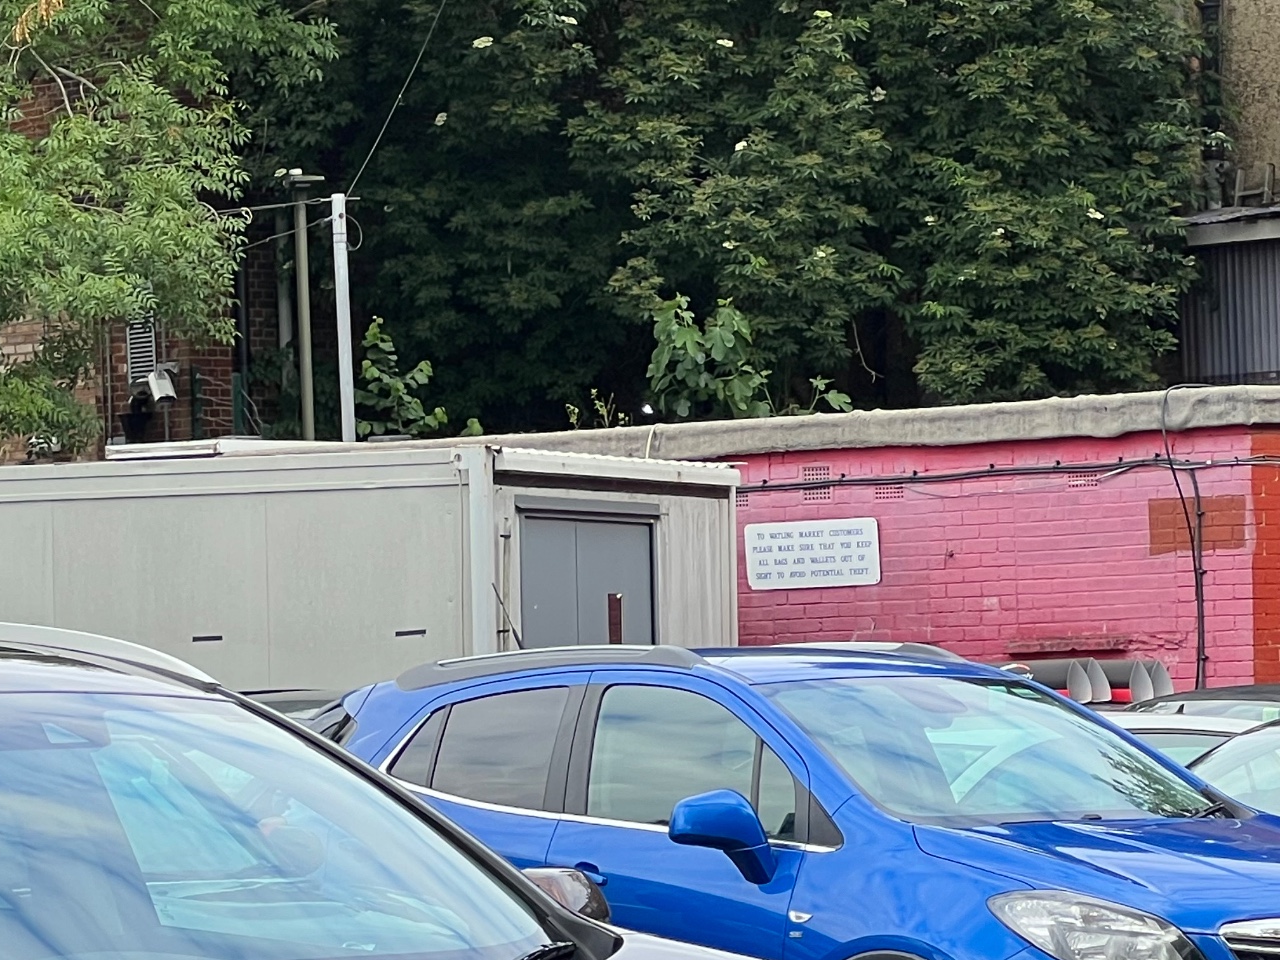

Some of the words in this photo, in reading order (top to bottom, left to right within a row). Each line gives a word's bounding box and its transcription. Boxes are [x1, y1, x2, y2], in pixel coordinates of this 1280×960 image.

[799, 530, 824, 538] MARKET
[829, 528, 863, 537] CUSTOMERS
[799, 543, 814, 551] SURE
[819, 542, 835, 550] THAT
[810, 556, 836, 564] WALLETS
[755, 572, 772, 580] SIGHT
[776, 571, 785, 579] TO
[810, 569, 844, 577] POTENTIAL
